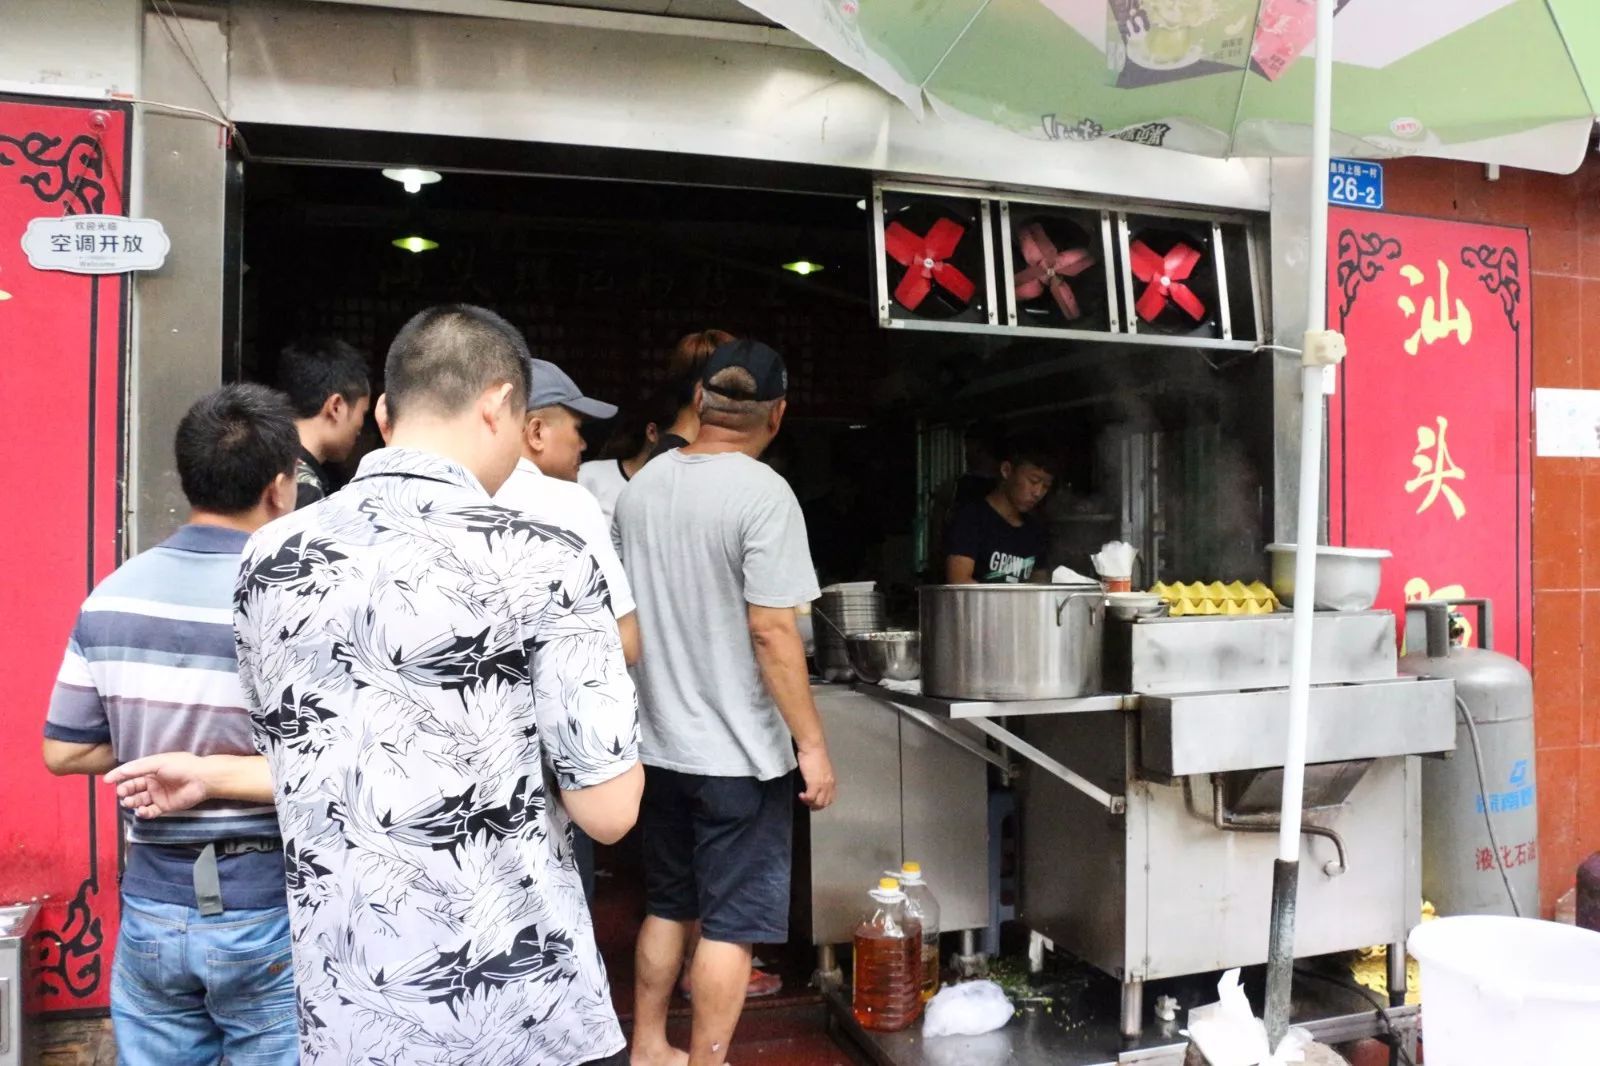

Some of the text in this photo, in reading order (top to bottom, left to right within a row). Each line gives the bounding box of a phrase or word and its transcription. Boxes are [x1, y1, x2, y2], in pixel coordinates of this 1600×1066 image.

[1332, 175, 1376, 204] 26-2
[50, 234, 143, 253] 空调开放
